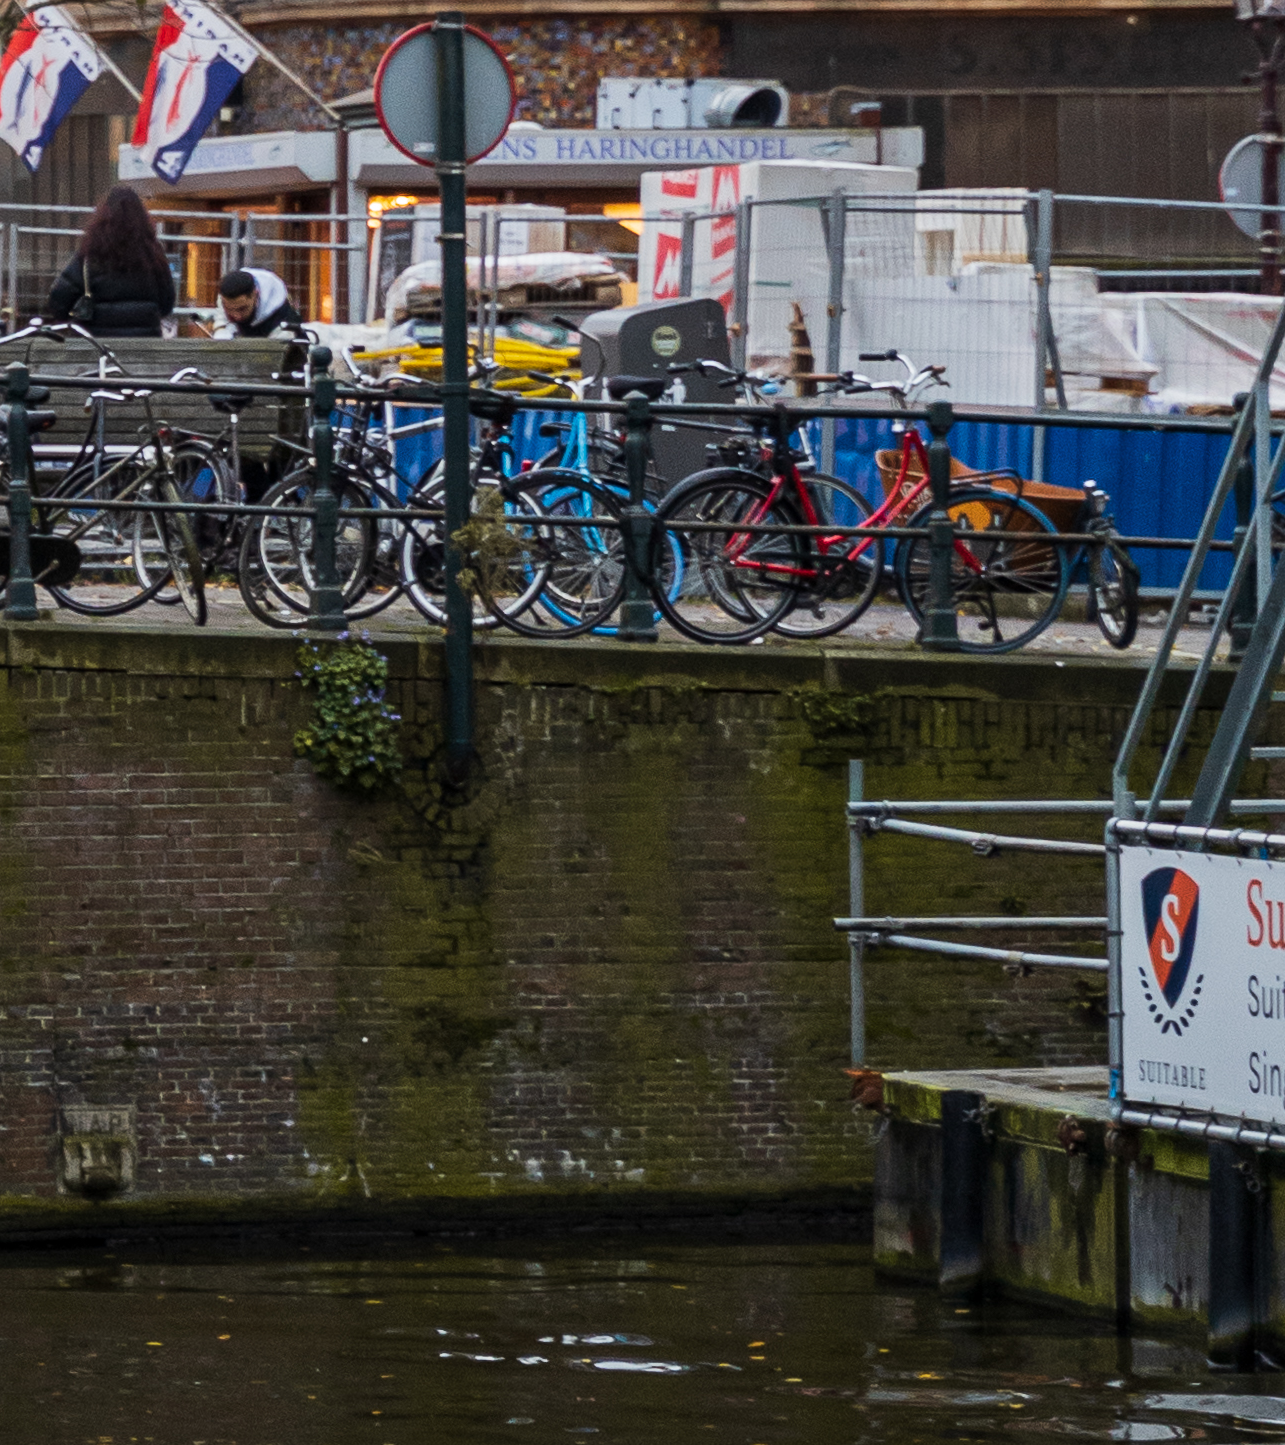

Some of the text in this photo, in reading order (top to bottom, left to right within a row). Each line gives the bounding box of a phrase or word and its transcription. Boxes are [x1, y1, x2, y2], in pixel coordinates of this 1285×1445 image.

[486, 136, 796, 160] NS HARINGHANDEL
[1247, 878, 1285, 950] Su
[1138, 1059, 1207, 1091] SUITABLE
